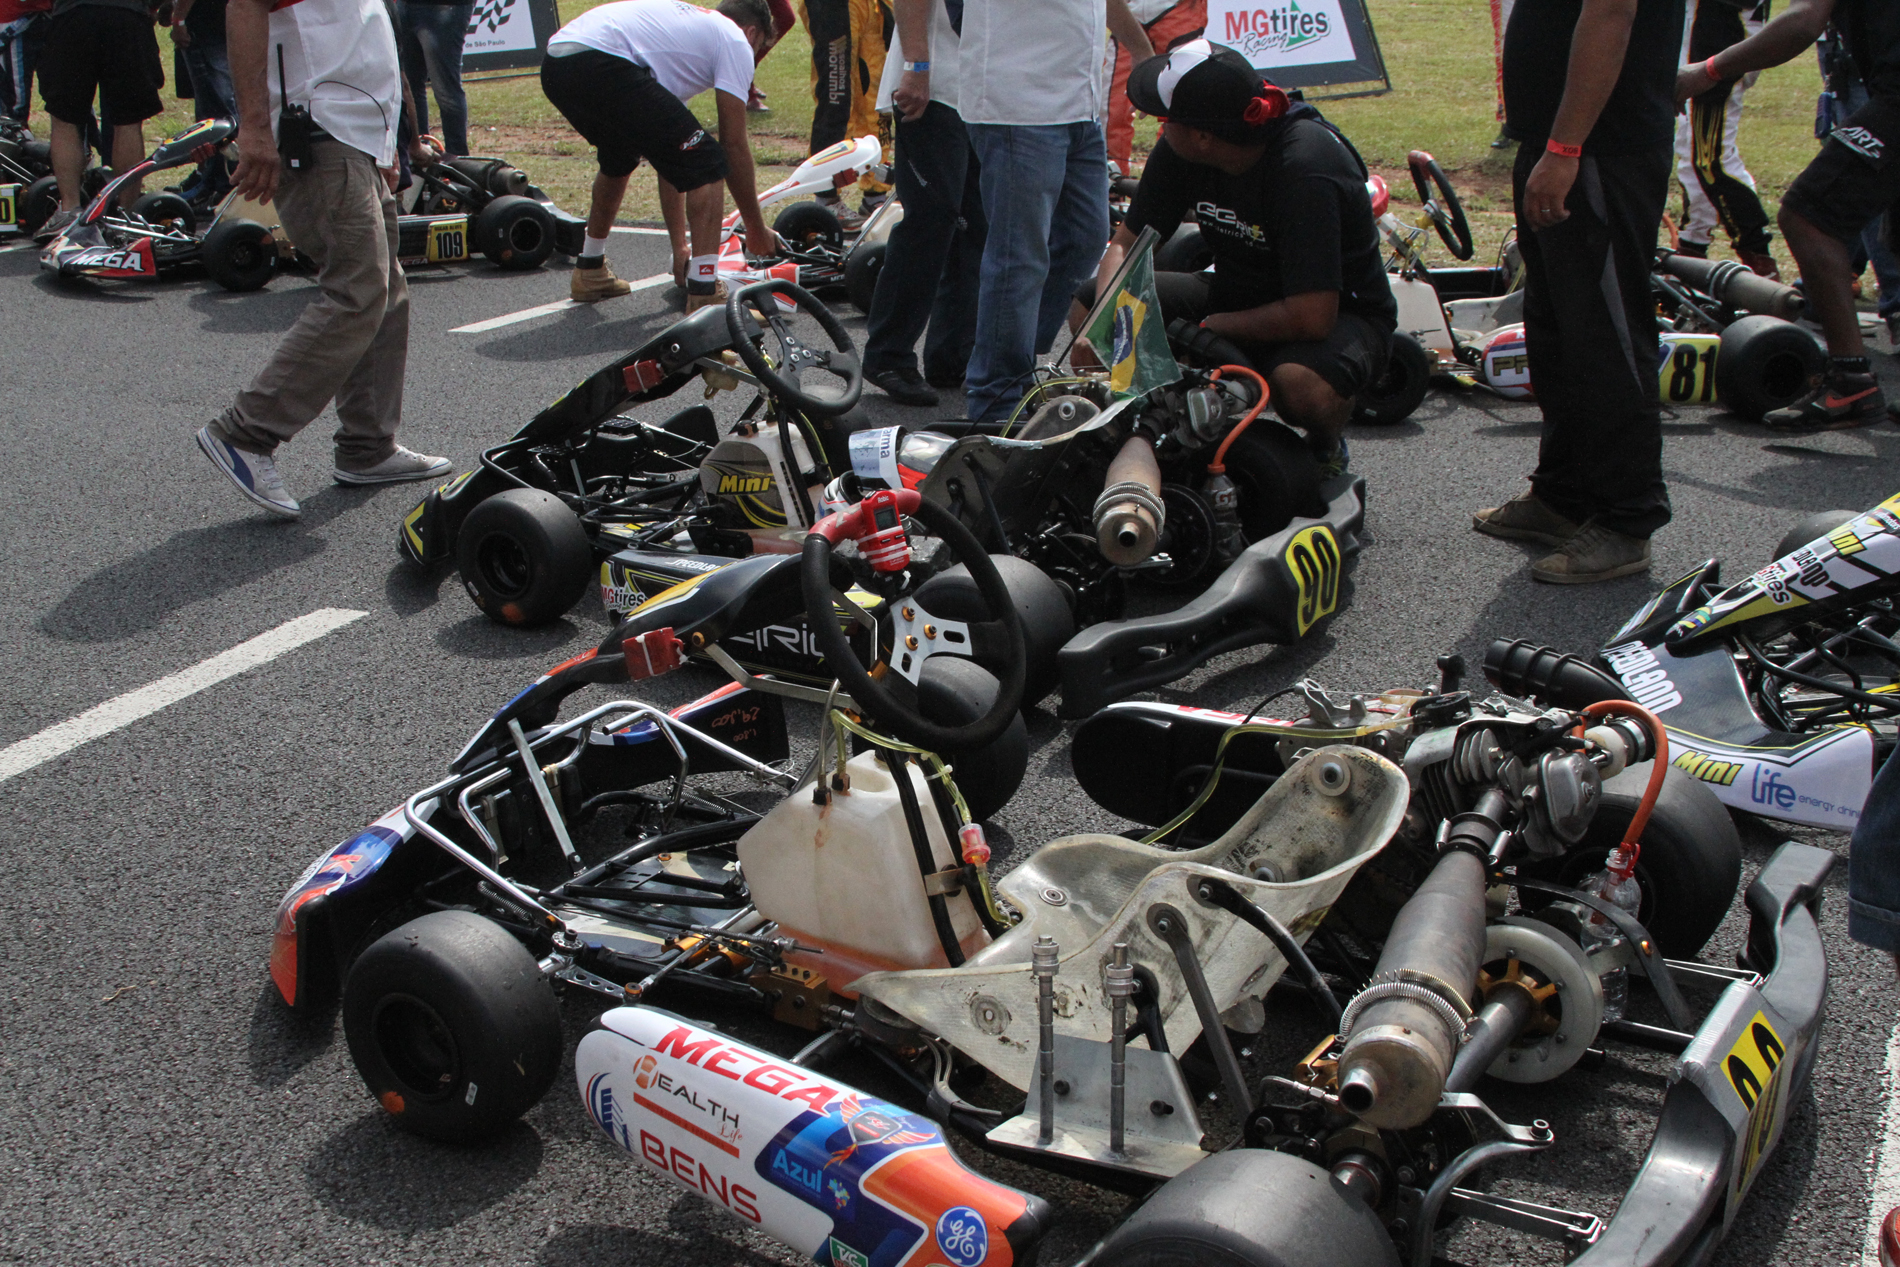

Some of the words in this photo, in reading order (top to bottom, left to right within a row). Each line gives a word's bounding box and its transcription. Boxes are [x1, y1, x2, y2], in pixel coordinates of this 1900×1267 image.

[1225, 7, 1329, 40] MGtires
[1244, 32, 1288, 53] Racing
[829, 42, 845, 104] morumbi
[70, 251, 144, 271] MEGA
[436, 230, 464, 259] 109
[1667, 343, 1717, 402] 81
[719, 475, 771, 493] Mini
[1292, 529, 1338, 628] 90
[1673, 750, 1744, 786] Mini
[1752, 763, 1796, 808] Life
[1798, 794, 1835, 812] energy
[649, 1024, 840, 1117] MEGA
[640, 1128, 762, 1224] BENS
[773, 1148, 823, 1193] Azul
